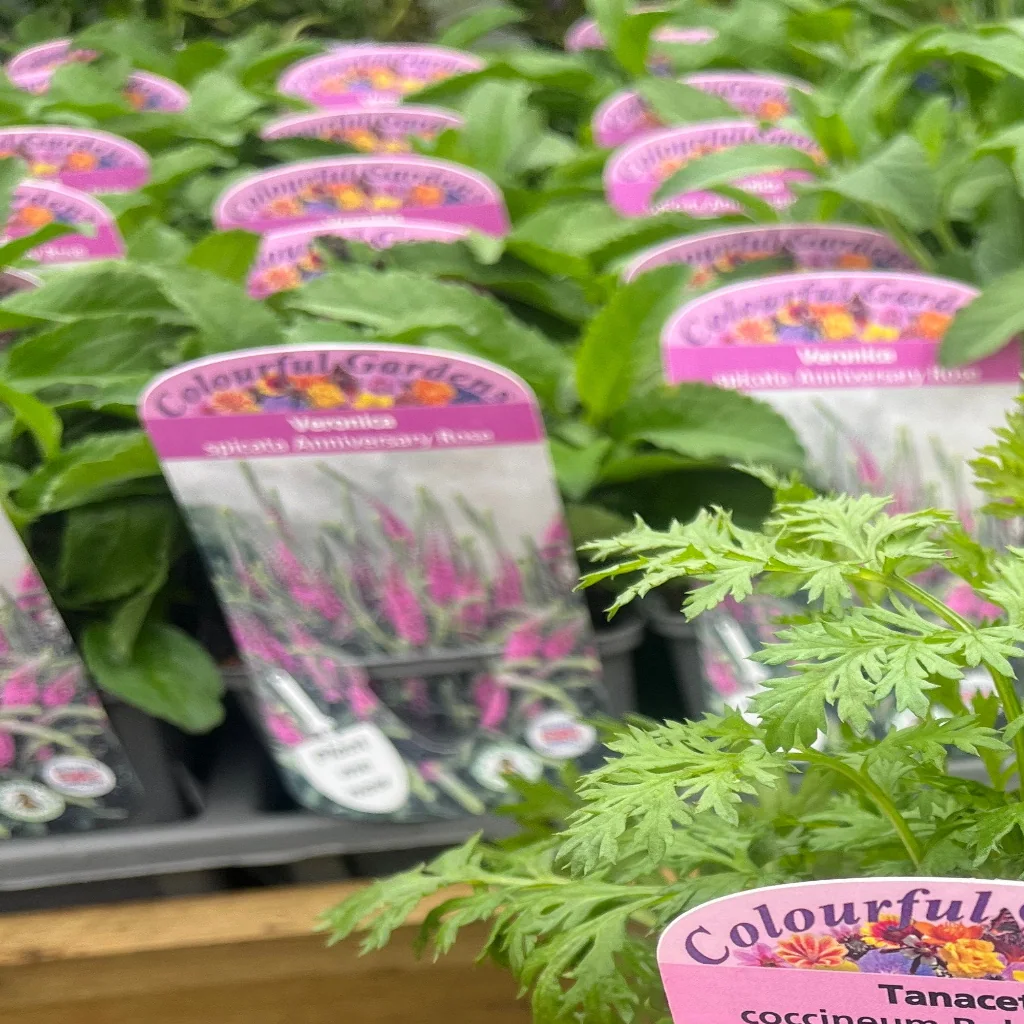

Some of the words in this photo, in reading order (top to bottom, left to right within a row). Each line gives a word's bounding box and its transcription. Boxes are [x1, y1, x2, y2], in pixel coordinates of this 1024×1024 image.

[796, 348, 896, 365] Veronica
[155, 350, 342, 418] Colourful
[346, 351, 512, 404] Gardens
[288, 413, 397, 433] Veronica
[293, 431, 433, 456] Anniversary
[685, 888, 996, 965] Colourful
